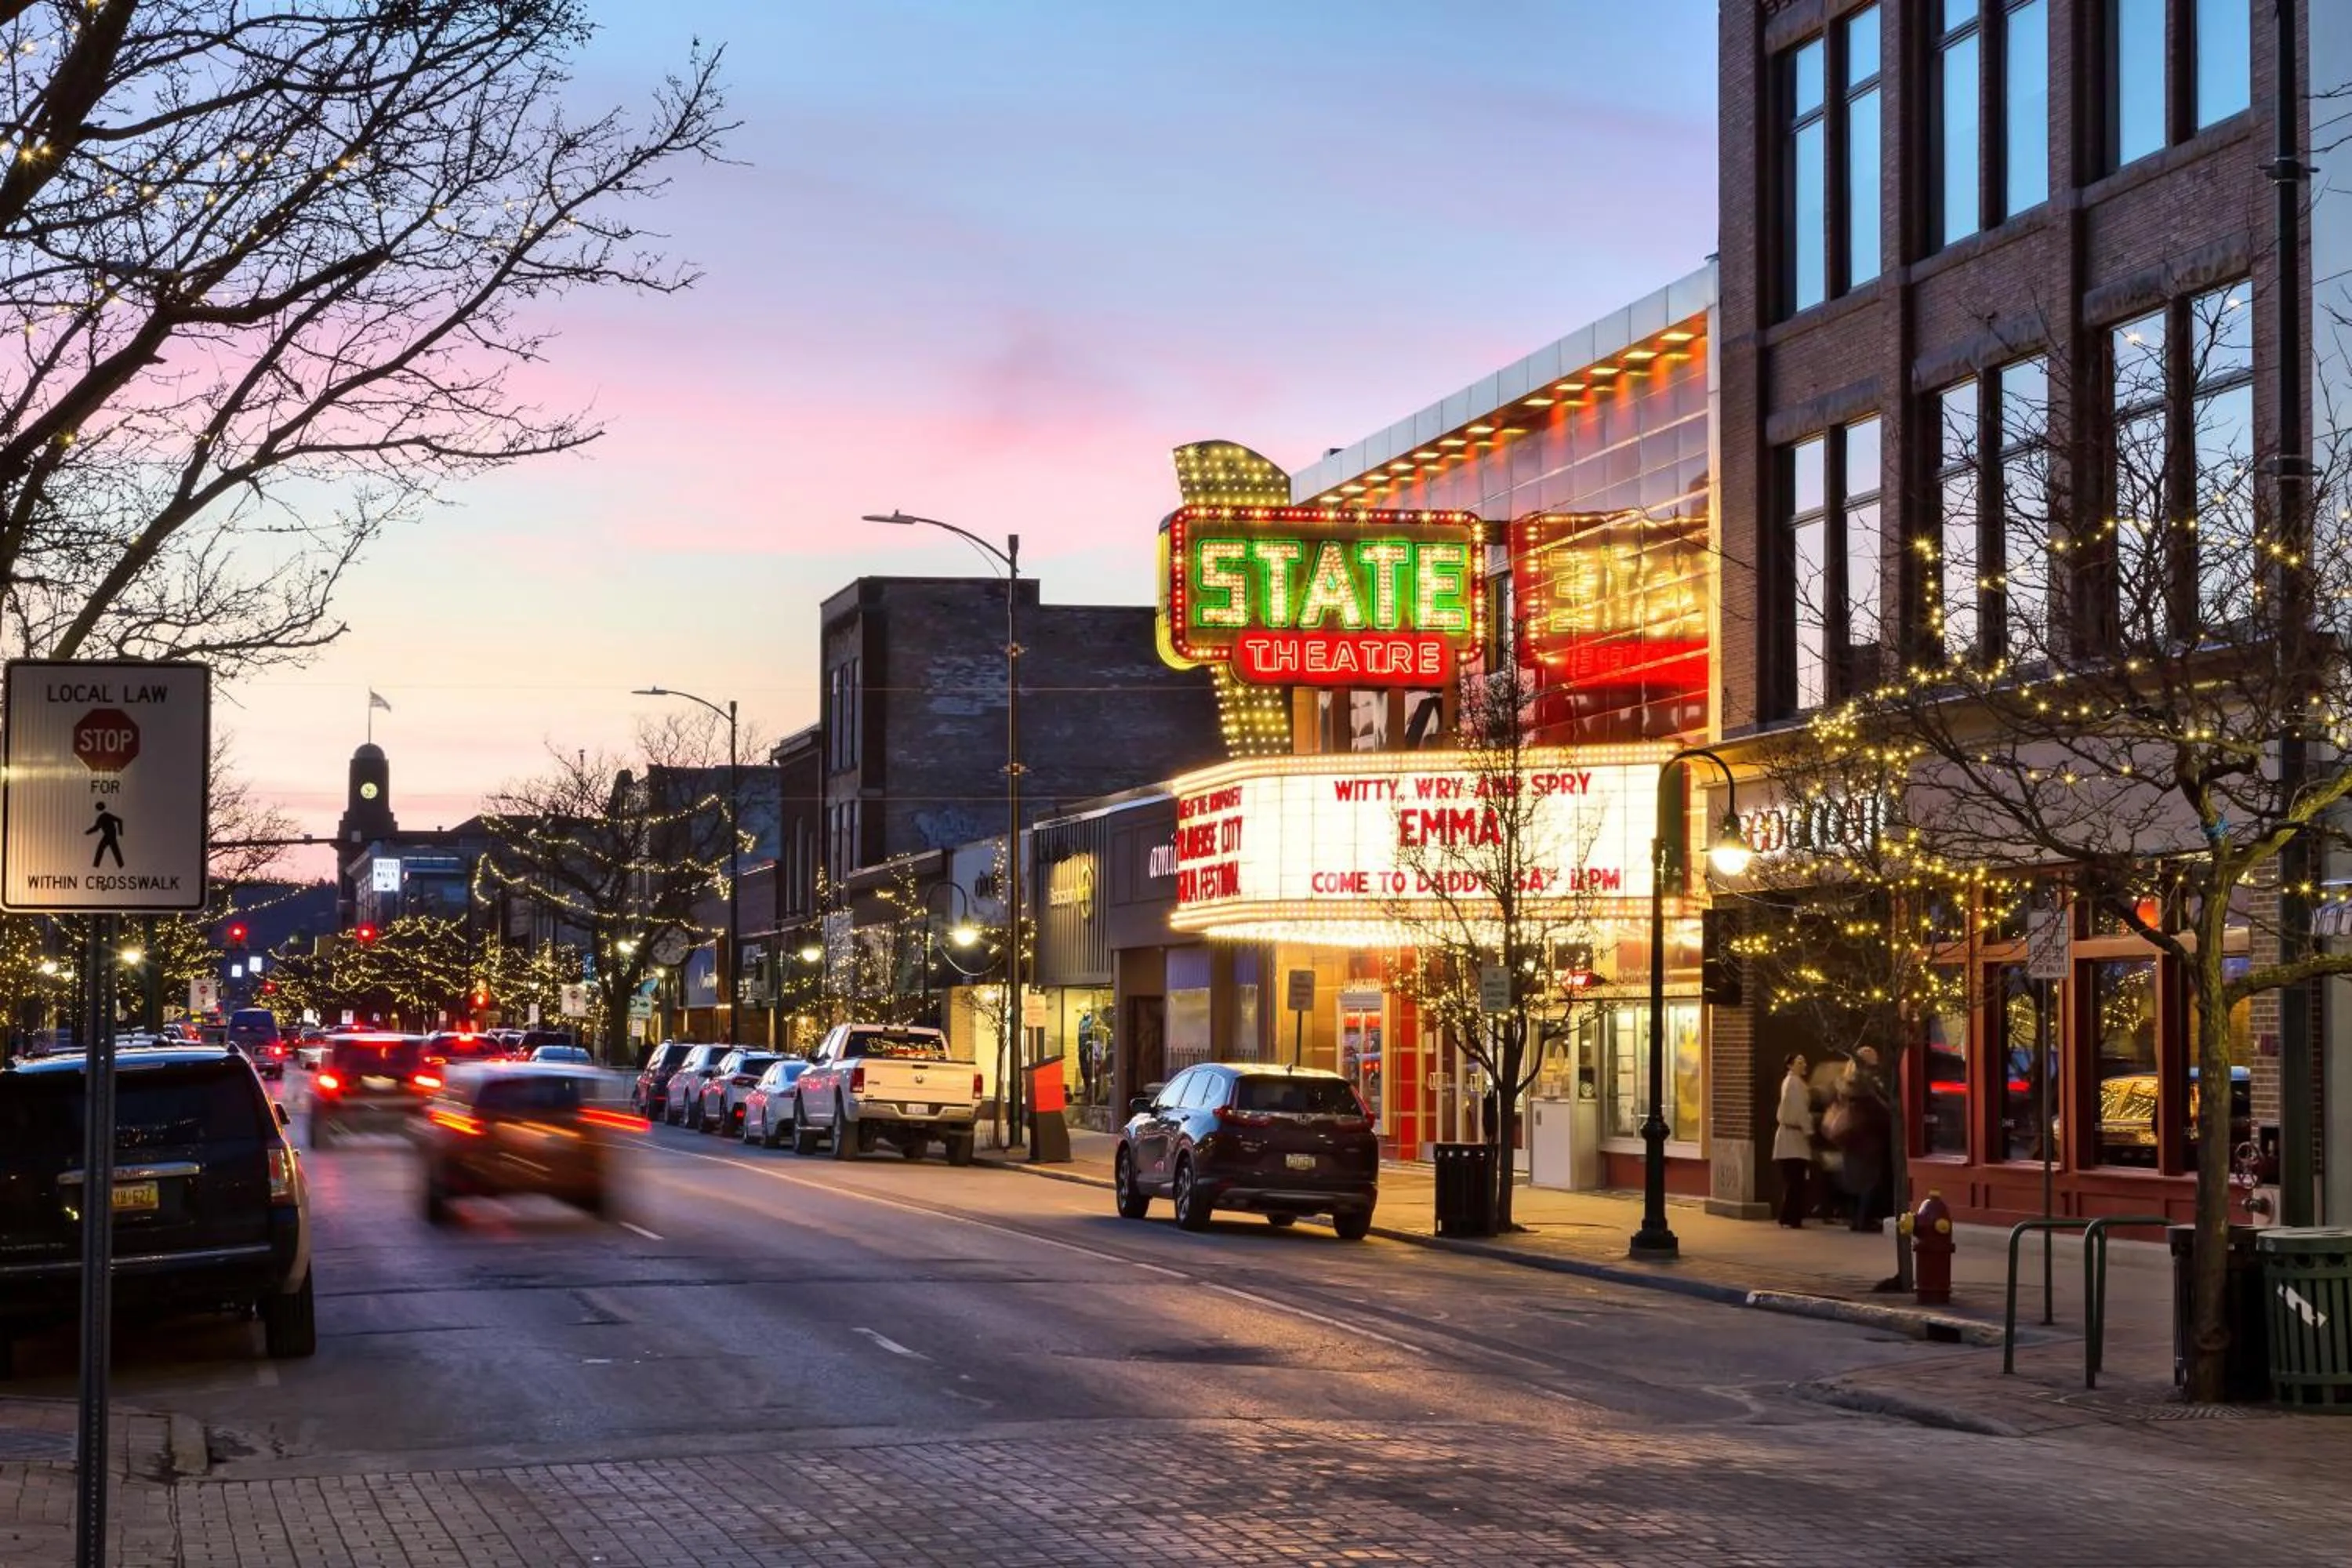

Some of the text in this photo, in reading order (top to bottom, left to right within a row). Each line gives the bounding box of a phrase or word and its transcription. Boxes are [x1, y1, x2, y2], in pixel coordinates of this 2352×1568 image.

[1196, 539, 1468, 630] STATE
[1245, 640, 1441, 674] THEATRE
[47, 684, 168, 703] LOCAL LAW
[80, 729, 133, 752] STOP
[90, 780, 120, 793] FOR
[1415, 778, 1464, 800] WRY
[1531, 771, 1592, 797] SPRY
[1222, 815, 1243, 853] CITY
[1399, 808, 1501, 848] EMMA
[28, 876, 180, 890] WITHIN CROSSWALK
[1312, 872, 1370, 893] COME
[1378, 871, 1406, 893] TO
